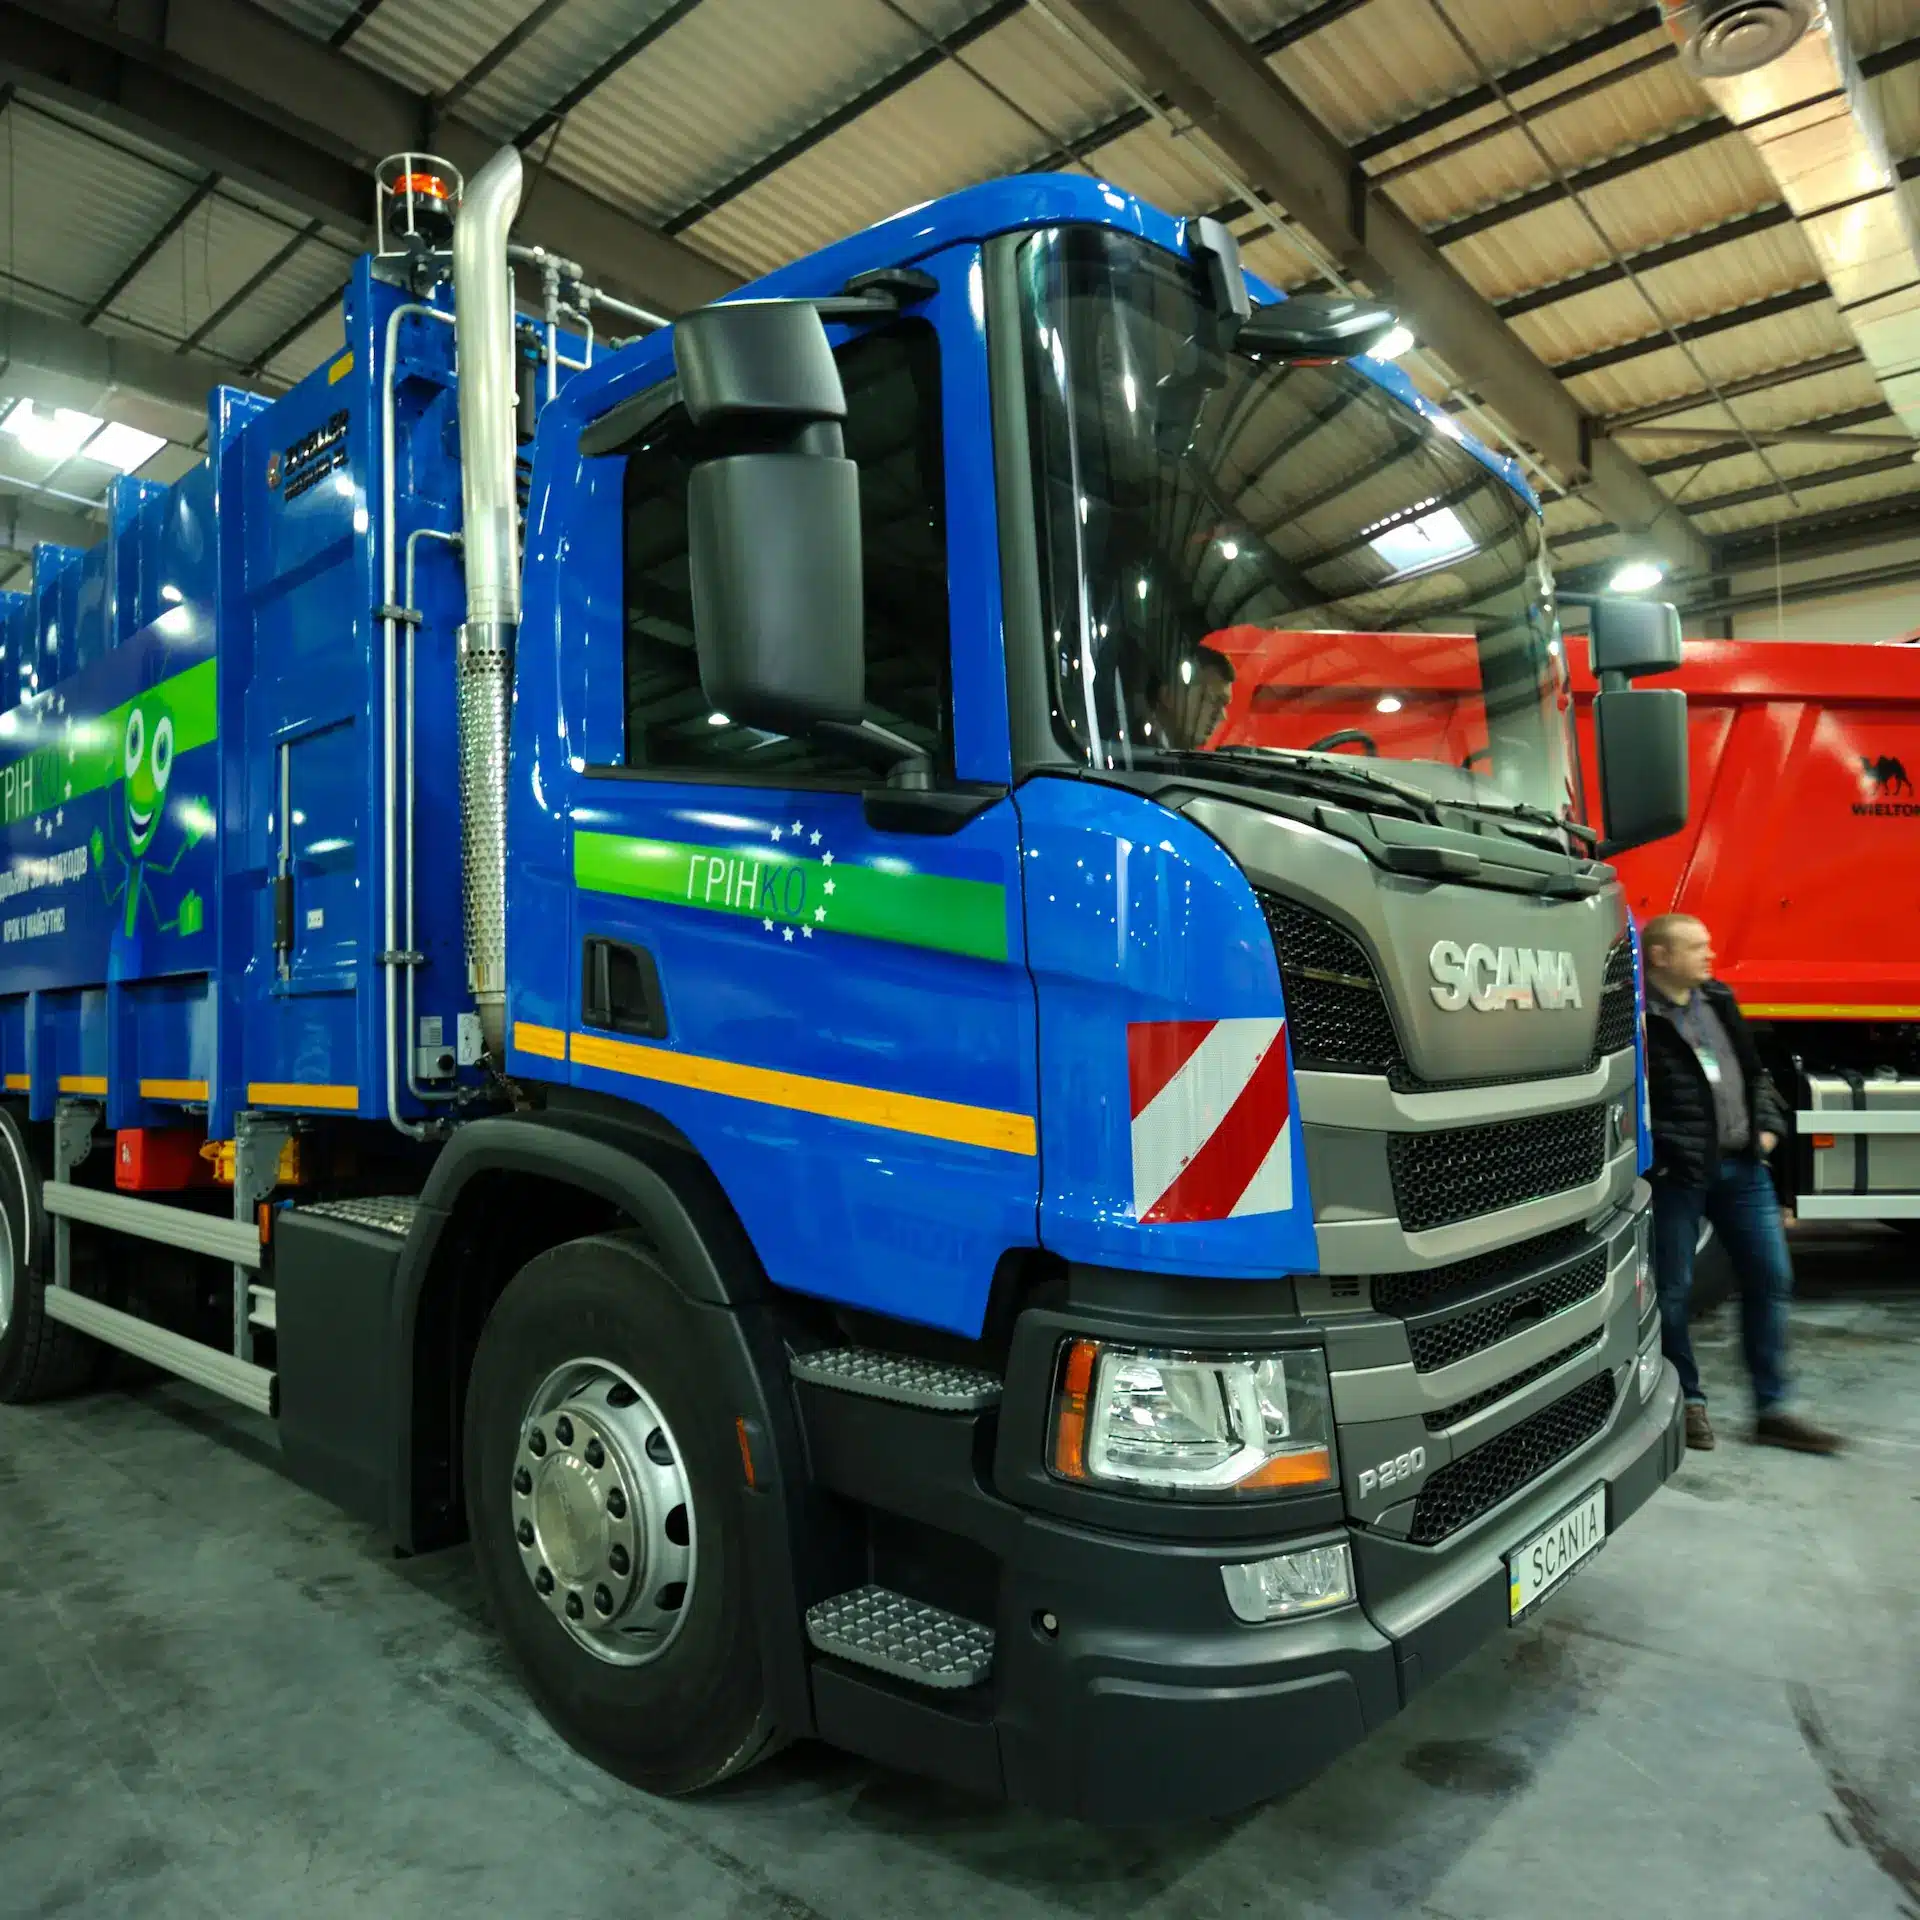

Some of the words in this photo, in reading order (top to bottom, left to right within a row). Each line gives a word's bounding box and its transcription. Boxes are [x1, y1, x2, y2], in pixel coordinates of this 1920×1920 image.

[687, 854, 807, 918] ГРІНКО
[1429, 939, 1583, 1013] SCANIA
[1358, 1445, 1427, 1500] P280
[1532, 1502, 1598, 1588] SCANIA
